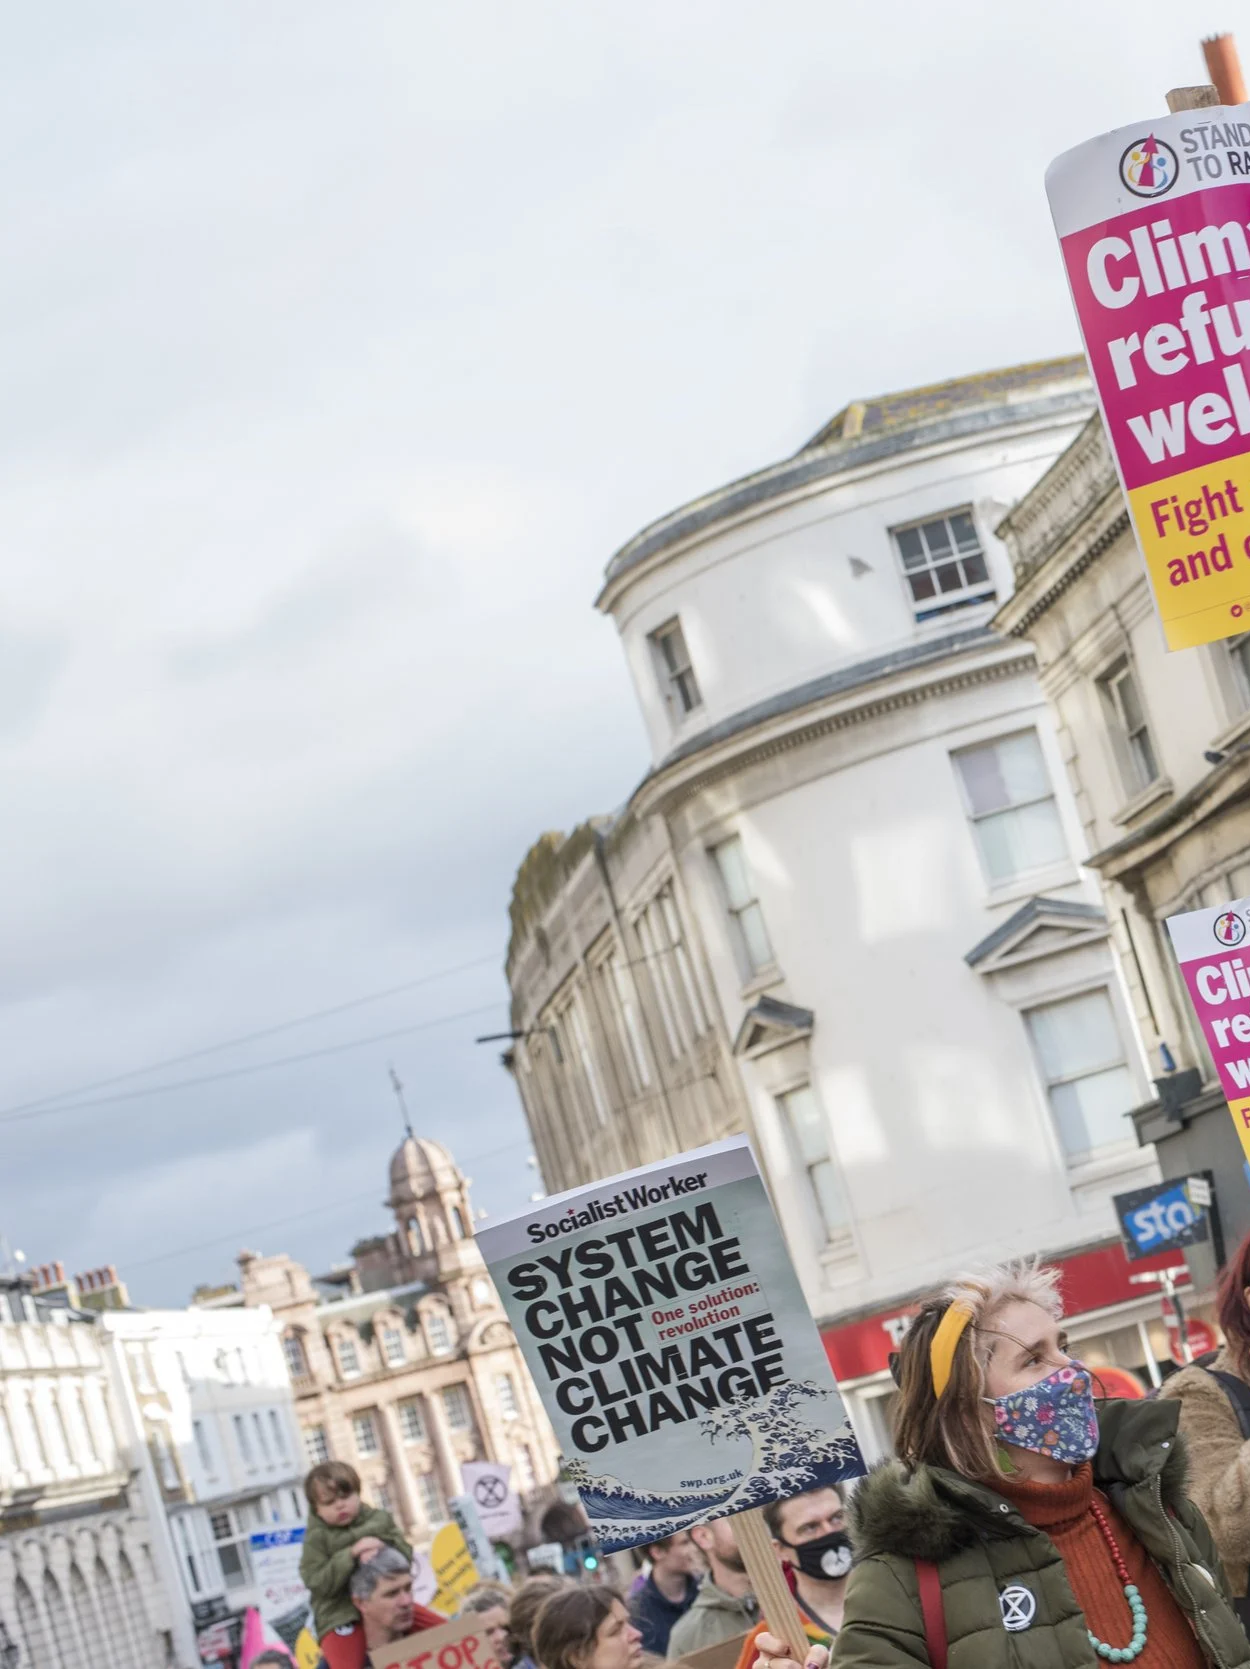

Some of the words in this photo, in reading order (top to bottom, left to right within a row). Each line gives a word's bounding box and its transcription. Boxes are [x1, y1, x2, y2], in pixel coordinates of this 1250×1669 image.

[1187, 154, 1223, 182] TO
[1150, 479, 1244, 538] Fight
[1167, 533, 1234, 587] and
[507, 1202, 724, 1302] SYSTEM
[524, 1237, 751, 1340] CHANGE
[651, 1306, 685, 1327] One
[688, 1282, 760, 1317] solution:
[537, 1313, 646, 1381] NOT
[658, 1304, 741, 1342] revolution
[555, 1312, 785, 1416] CLIMATE
[570, 1353, 786, 1453] CHANGE
[680, 1468, 744, 1490] swp.org.uk
